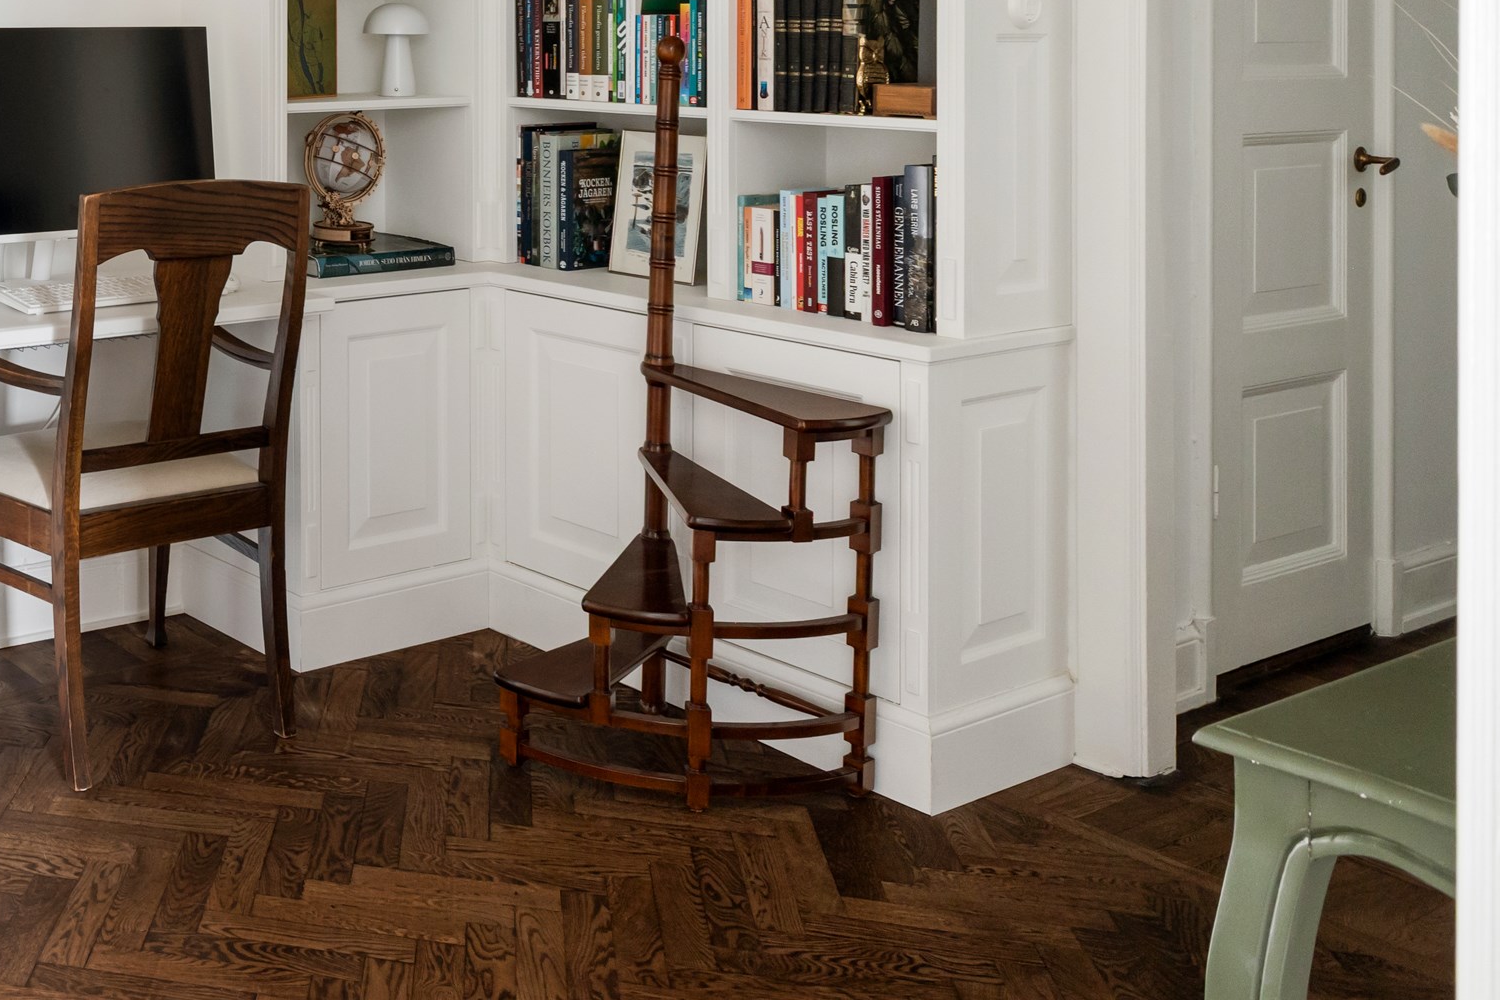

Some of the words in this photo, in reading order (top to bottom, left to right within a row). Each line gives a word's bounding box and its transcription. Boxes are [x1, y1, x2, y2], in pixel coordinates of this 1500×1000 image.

[543, 142, 551, 207] BONNIERS
[578, 187, 613, 198] JÄGAREN
[910, 188, 918, 210] LARS
[862, 209, 871, 218] VAD
[911, 213, 919, 235] LERIN
[543, 211, 551, 263] KOKBOK
[875, 209, 883, 249] STÅLENHAG
[862, 239, 871, 251] MED
[396, 256, 410, 264] FRÅN
[863, 252, 871, 261] VÅR
[894, 206, 905, 308] GENTLEMANNEN
[849, 261, 858, 284] Cabin
[863, 262, 871, 284] PLANET?
[849, 285, 857, 304] Porn
